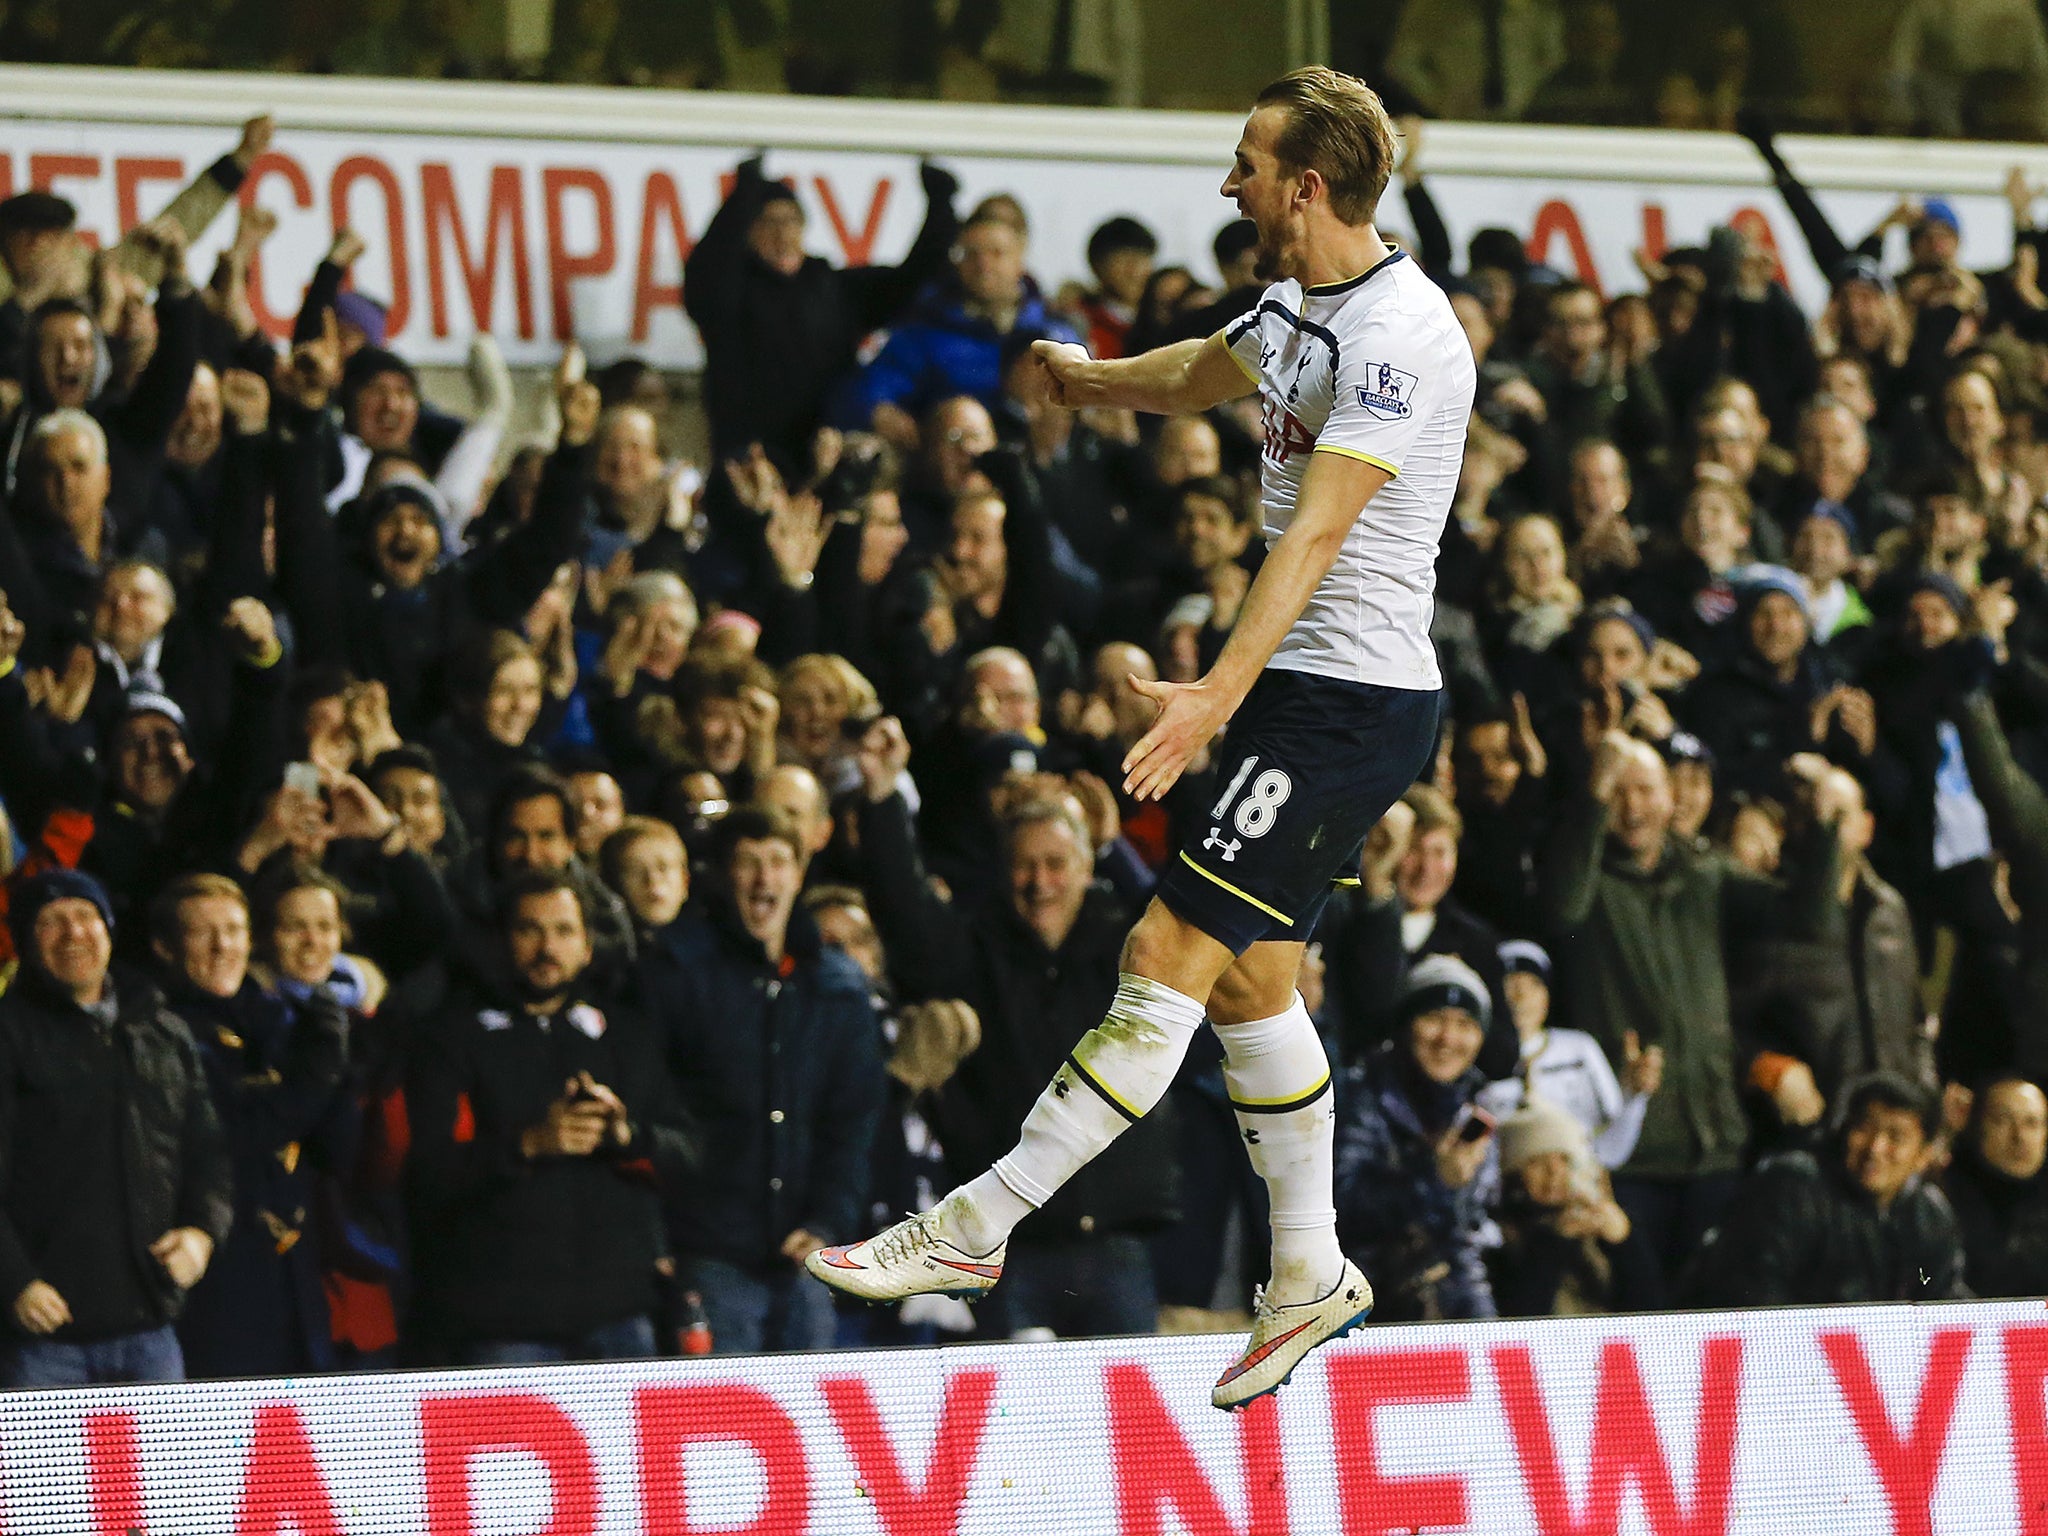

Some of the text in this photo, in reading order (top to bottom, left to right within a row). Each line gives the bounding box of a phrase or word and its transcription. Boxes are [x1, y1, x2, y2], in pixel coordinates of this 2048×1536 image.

[237, 151, 893, 343] COMPAY
[1210, 756, 1292, 838] 18
[82, 1364, 1001, 1536] APPY
[1103, 1332, 1744, 1536] NEW
